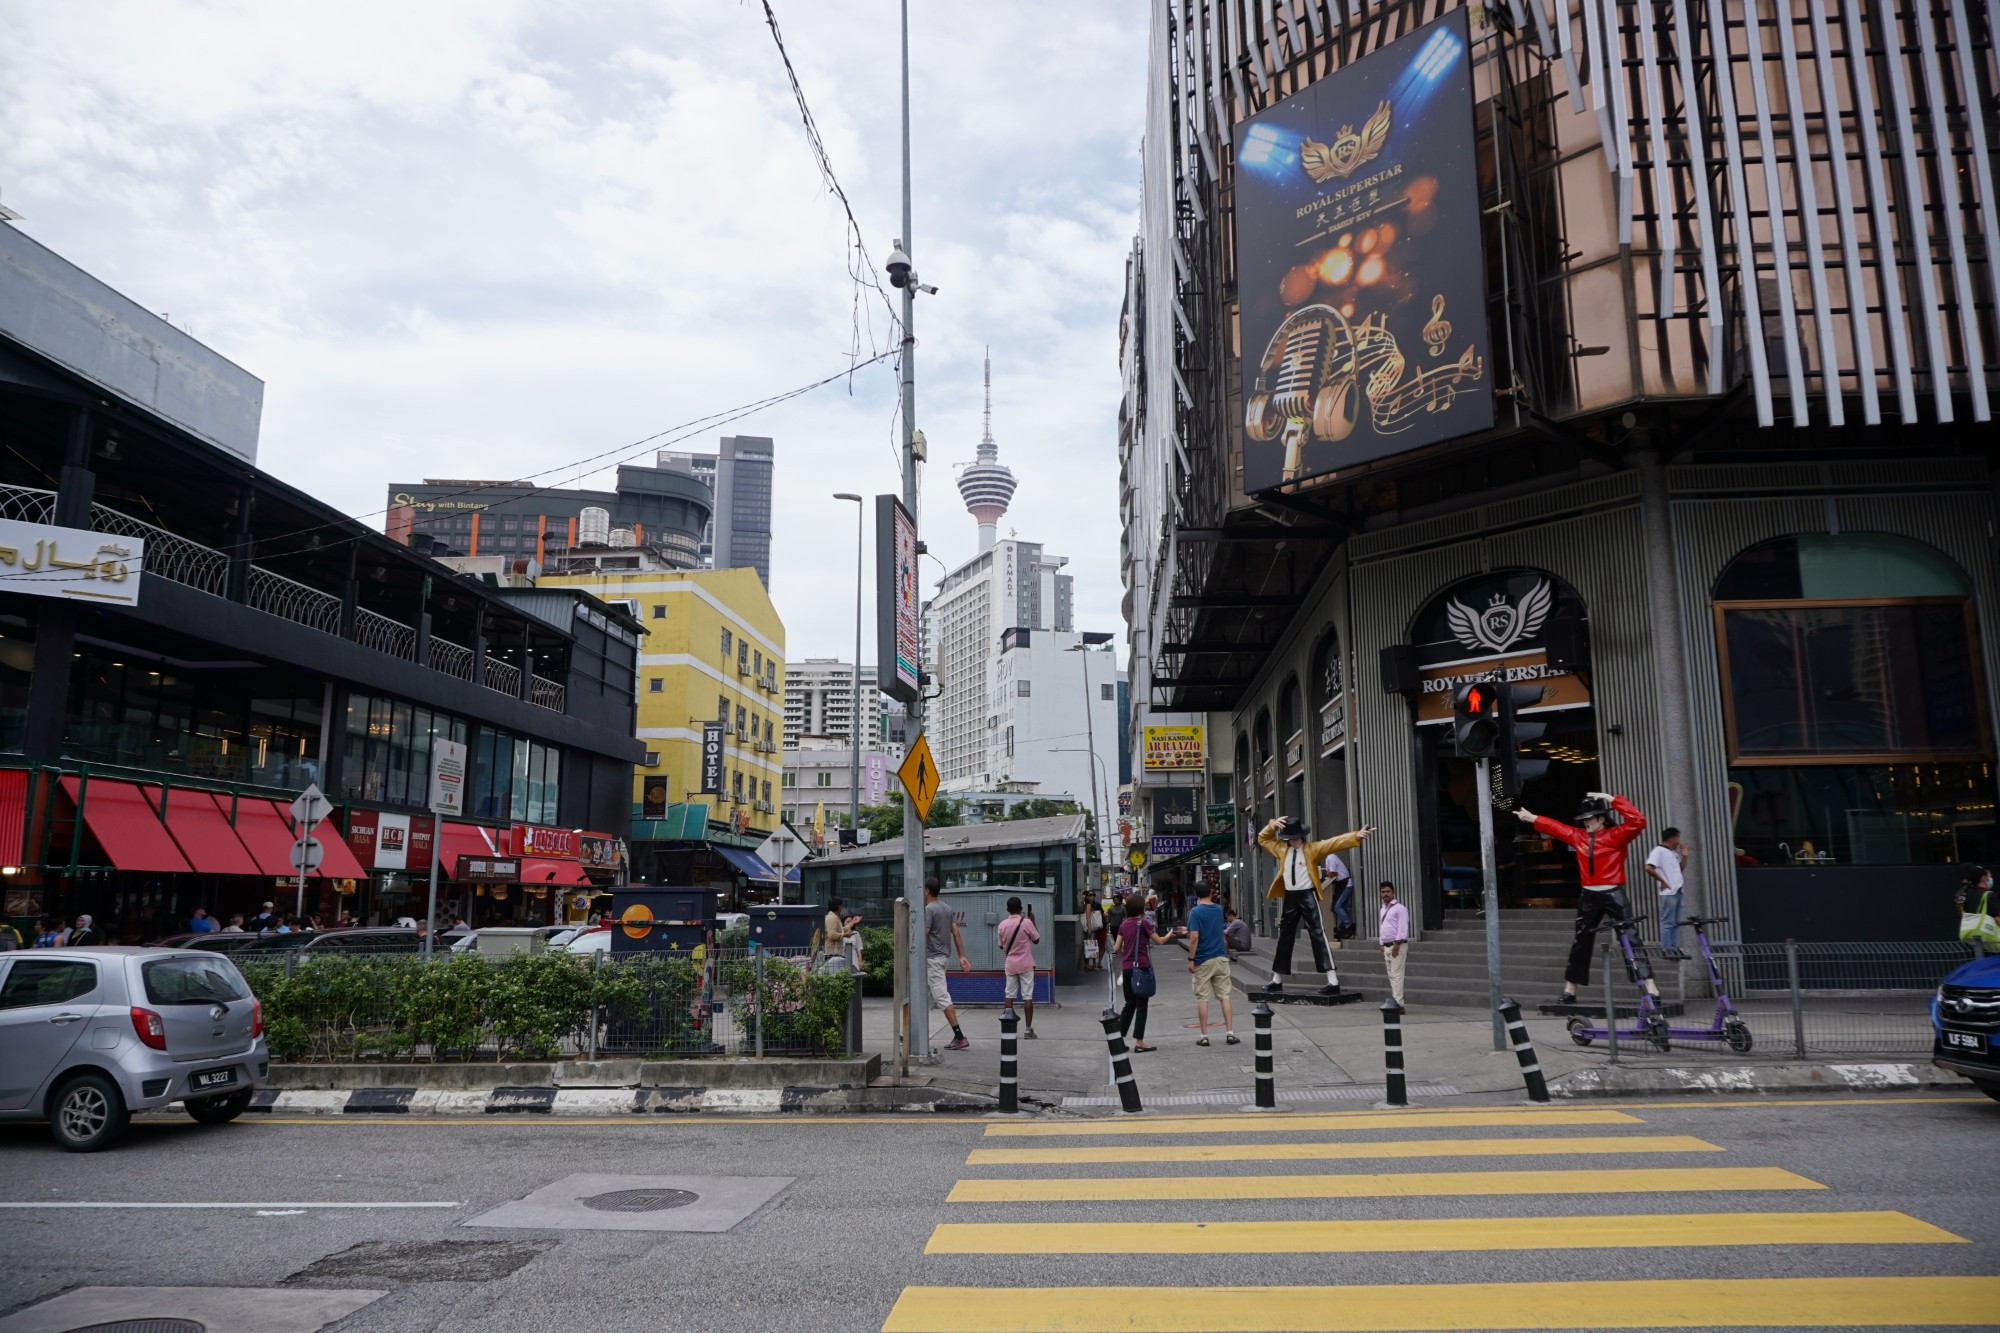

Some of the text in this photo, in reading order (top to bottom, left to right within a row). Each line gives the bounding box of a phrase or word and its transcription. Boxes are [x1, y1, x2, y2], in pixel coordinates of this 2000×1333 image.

[1337, 144, 1356, 159] RS
[1296, 164, 1403, 218] ROYAL SUPERSTAR
[438, 501, 455, 509] with
[457, 502, 489, 511] Bintang
[1490, 614, 1509, 630] RS
[1148, 742, 1161, 751] AR
[706, 731, 719, 789] HOTEL
[351, 826, 375, 835] SICHUAN
[383, 829, 403, 841] HCB
[411, 832, 431, 841] HOTPOT
[1153, 839, 1197, 847] HOTEL
[199, 1071, 228, 1085] VAL 3227
